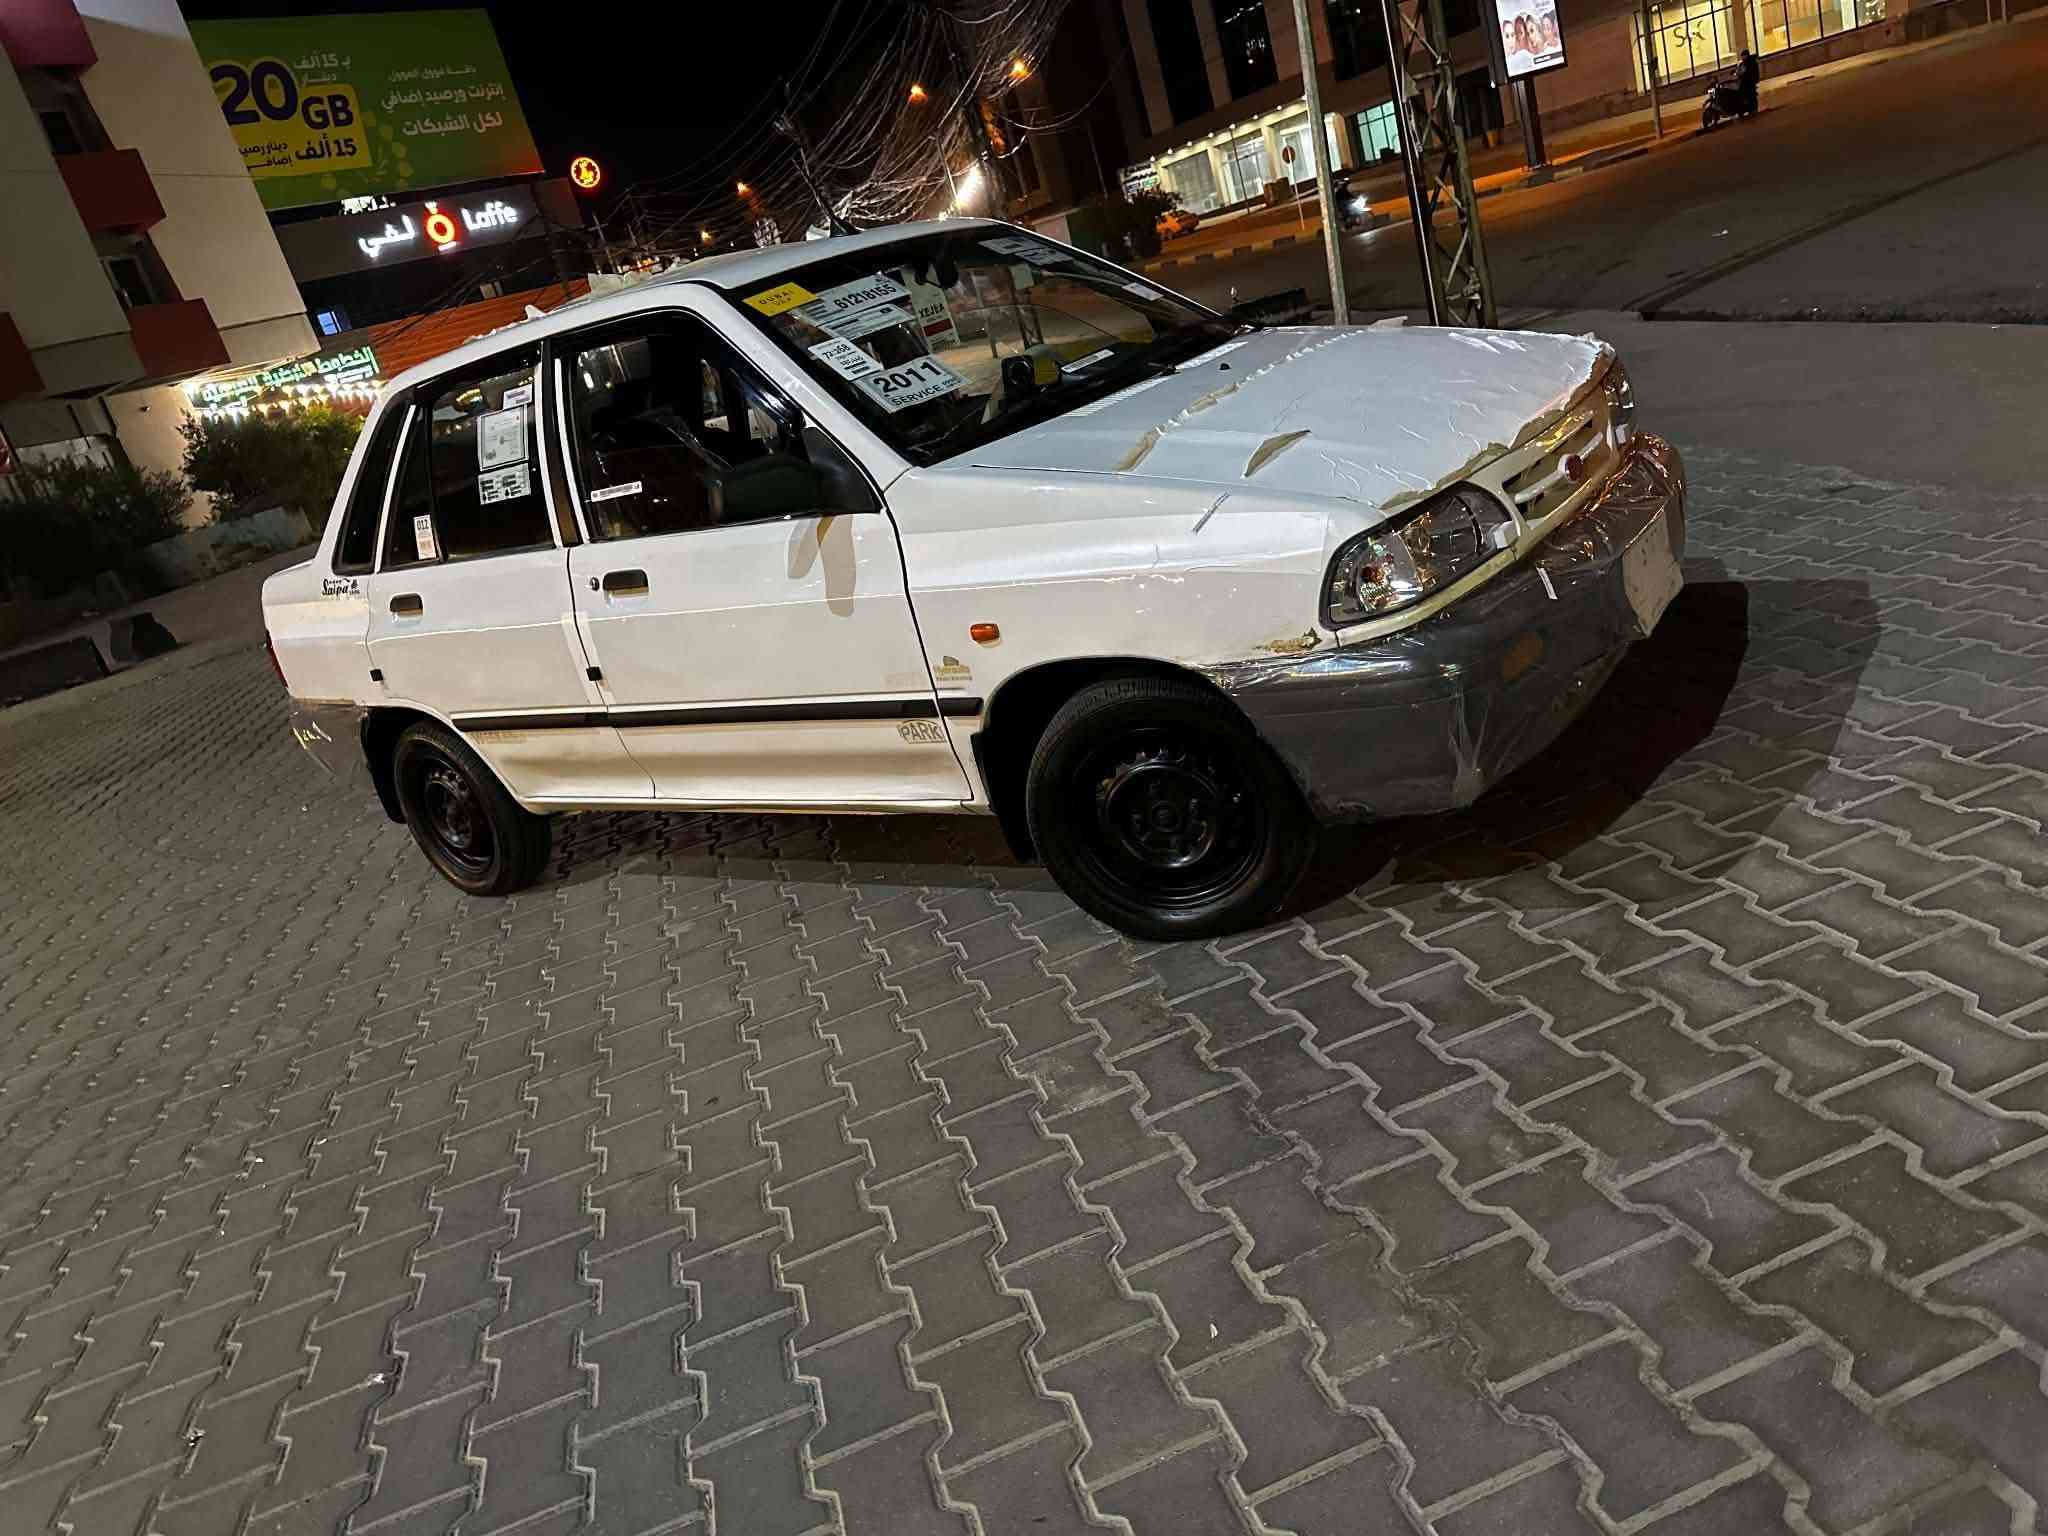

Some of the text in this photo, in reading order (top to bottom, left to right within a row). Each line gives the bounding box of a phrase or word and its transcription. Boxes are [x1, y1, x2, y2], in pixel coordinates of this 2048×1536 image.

[209, 61, 354, 130] 20 GB
[401, 111, 504, 137] لكل الشبكات
[295, 133, 357, 161] 15 ألف
[460, 200, 518, 231] Laffe
[873, 361, 942, 394] 2011
[894, 384, 945, 407] SERVICE
[322, 578, 349, 597] Saipa
